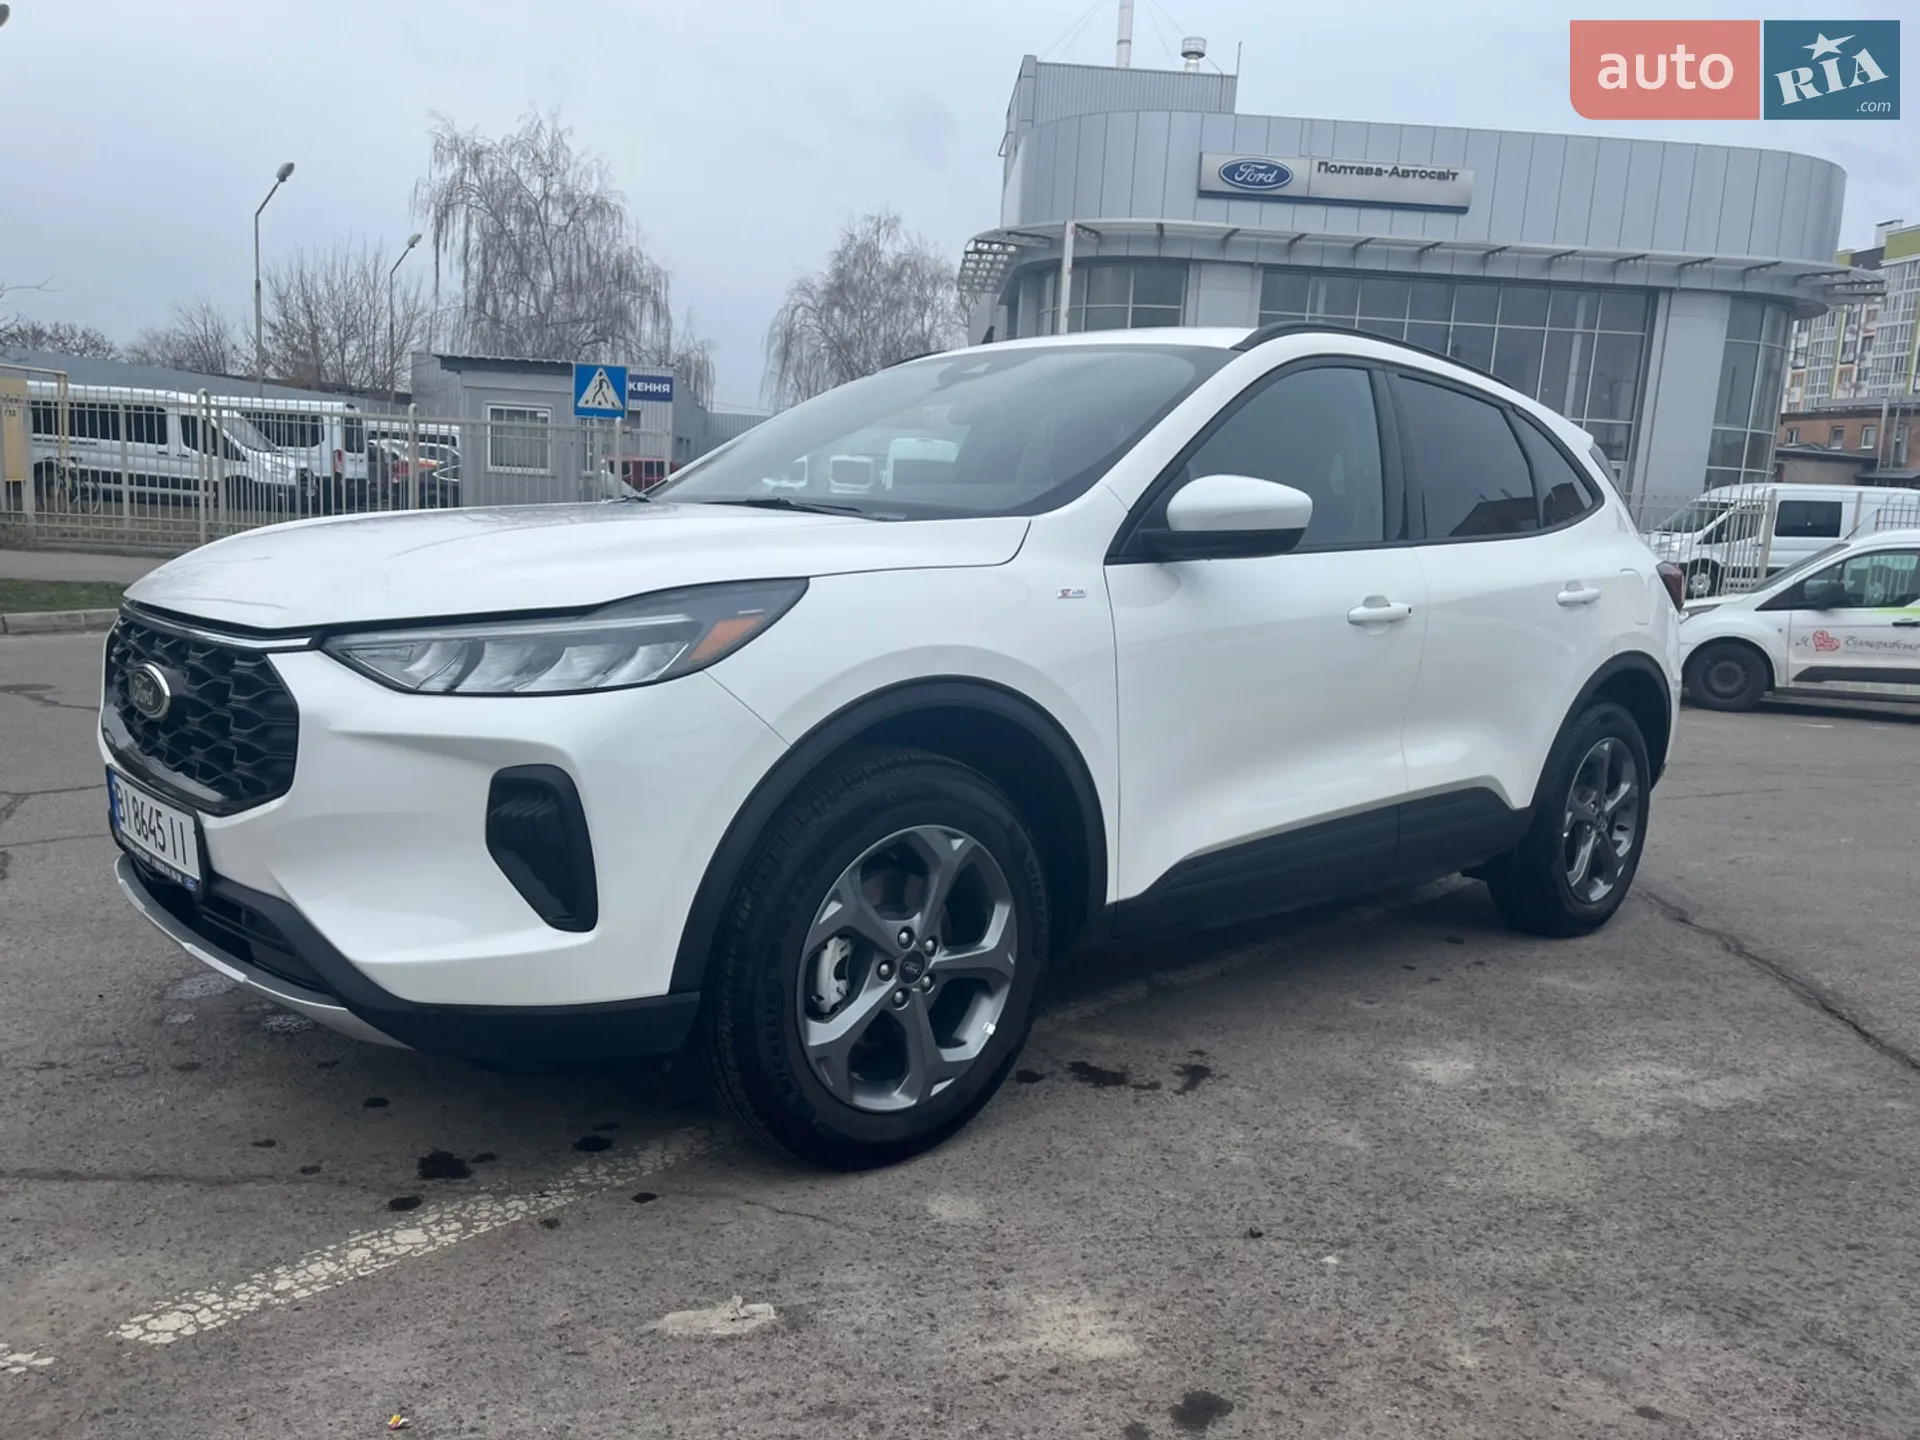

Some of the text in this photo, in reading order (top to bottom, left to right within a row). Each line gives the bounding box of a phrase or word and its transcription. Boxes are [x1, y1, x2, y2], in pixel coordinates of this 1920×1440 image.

[1234, 162, 1279, 184] Ford
[1317, 161, 1460, 182] Полтава-Автосвіт
[133, 673, 153, 706] Ford
[132, 796, 166, 854] 8645
